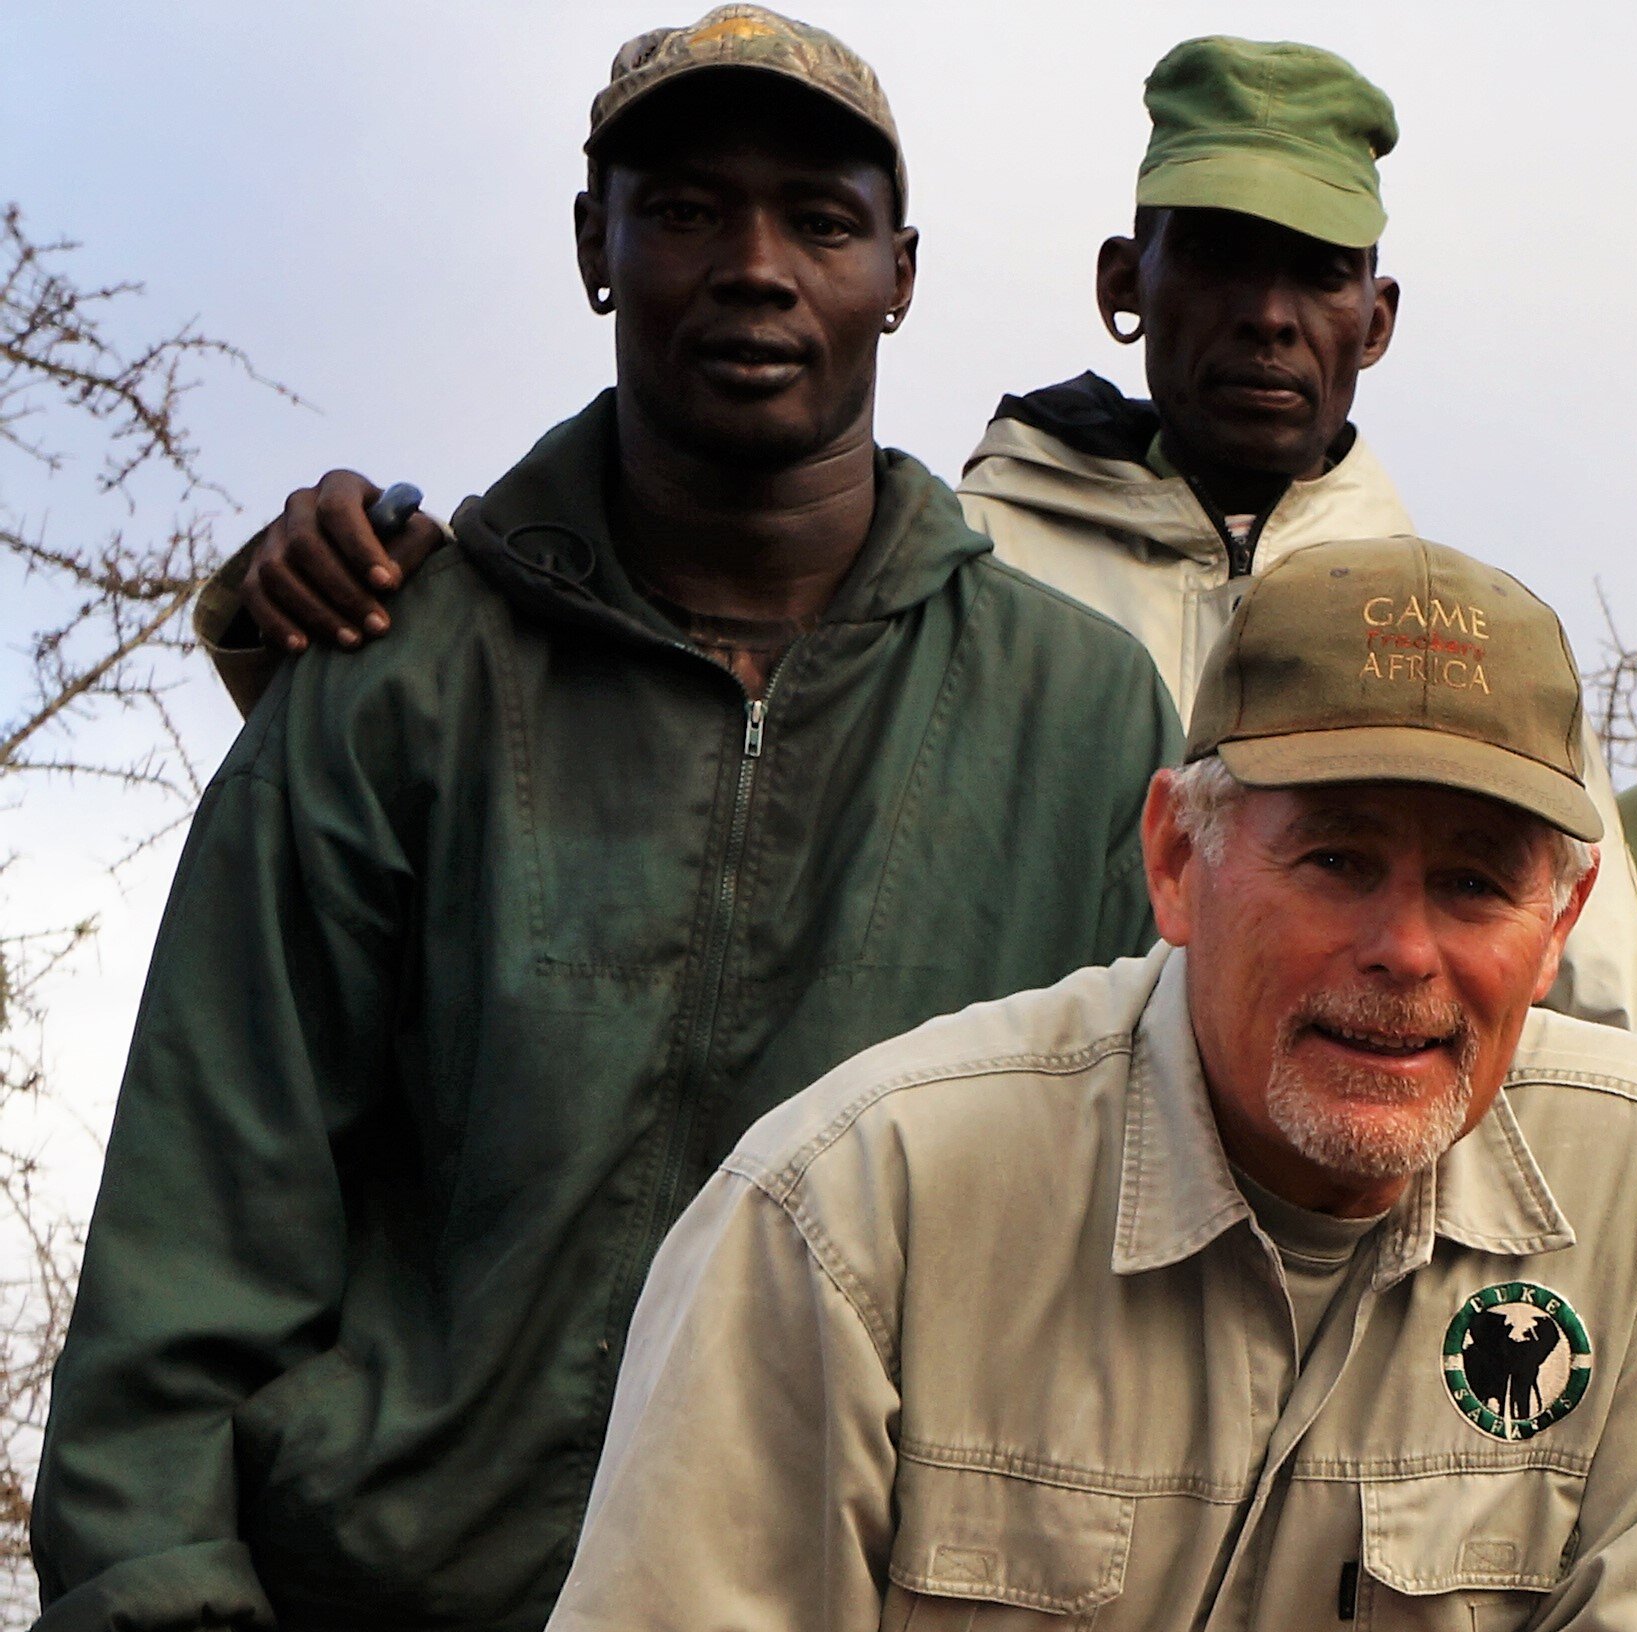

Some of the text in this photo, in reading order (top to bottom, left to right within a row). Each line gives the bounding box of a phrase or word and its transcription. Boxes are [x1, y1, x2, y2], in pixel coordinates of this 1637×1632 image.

[1363, 594, 1490, 640] GAME
[1359, 651, 1491, 695] AFRICA
[1469, 1286, 1562, 1314] DUKE
